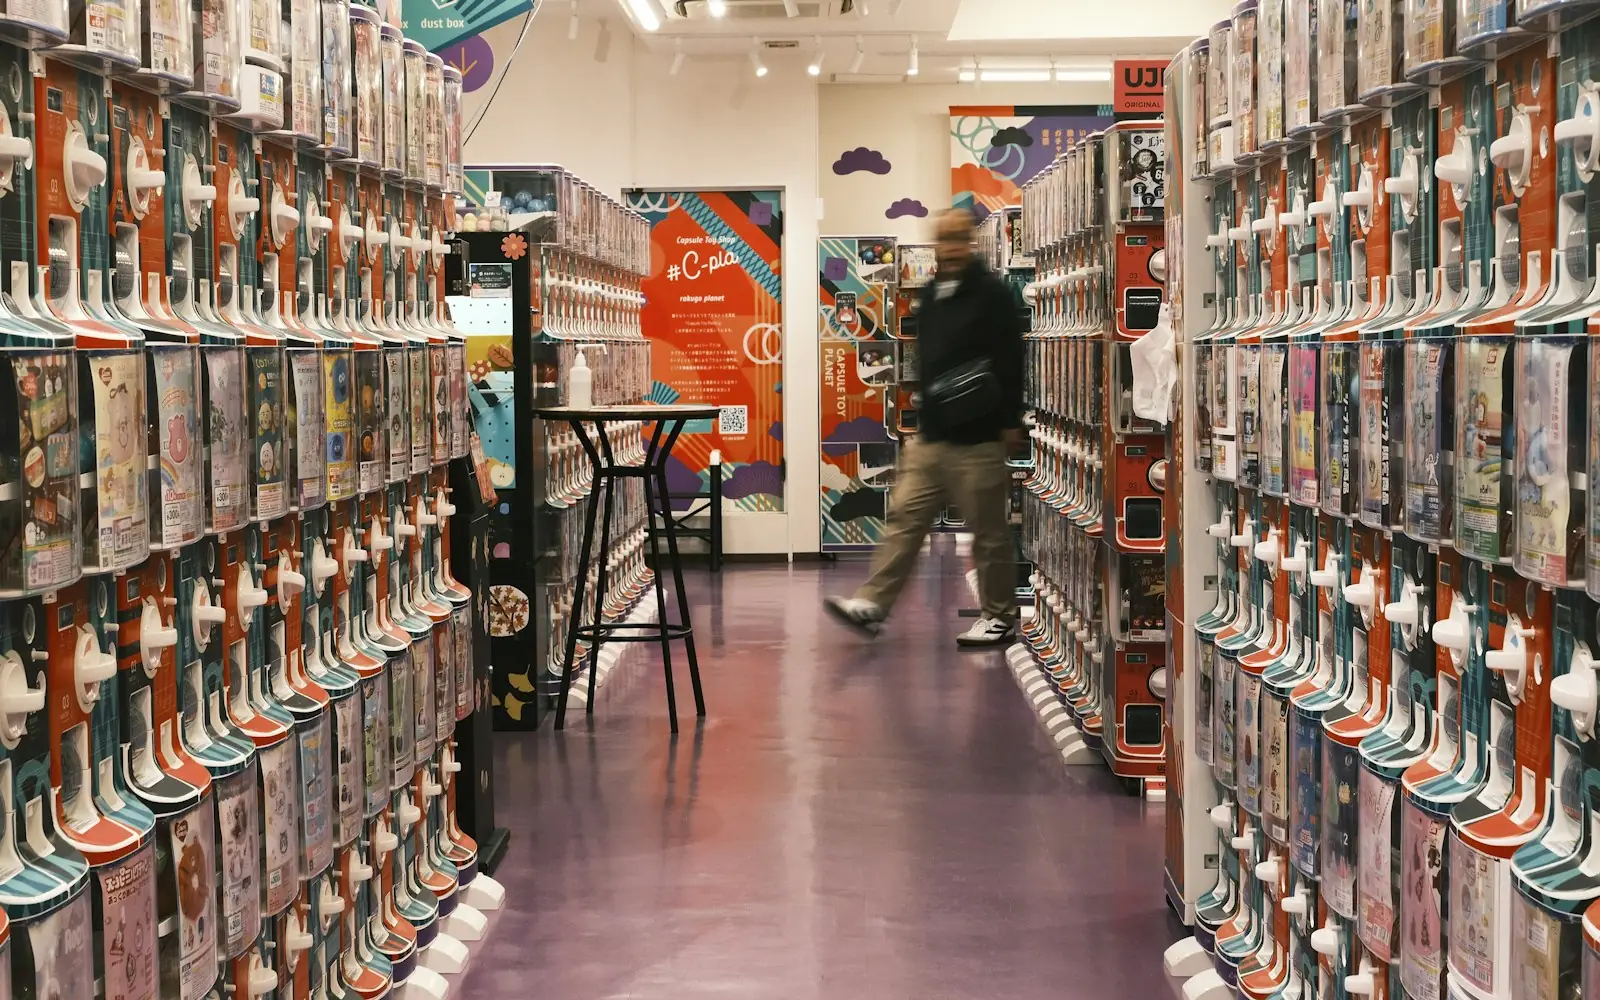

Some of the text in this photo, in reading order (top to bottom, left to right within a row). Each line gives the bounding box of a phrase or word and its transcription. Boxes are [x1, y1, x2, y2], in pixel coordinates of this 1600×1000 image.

[421, 18, 443, 29] dust
[446, 17, 465, 28] box
[676, 235, 736, 246] Capsule Toy Shop
[666, 250, 739, 282] #C-pla
[680, 294, 725, 304] rakugo planet
[824, 348, 834, 387] PLANET
[836, 348, 846, 417] CAPSULE TOY
